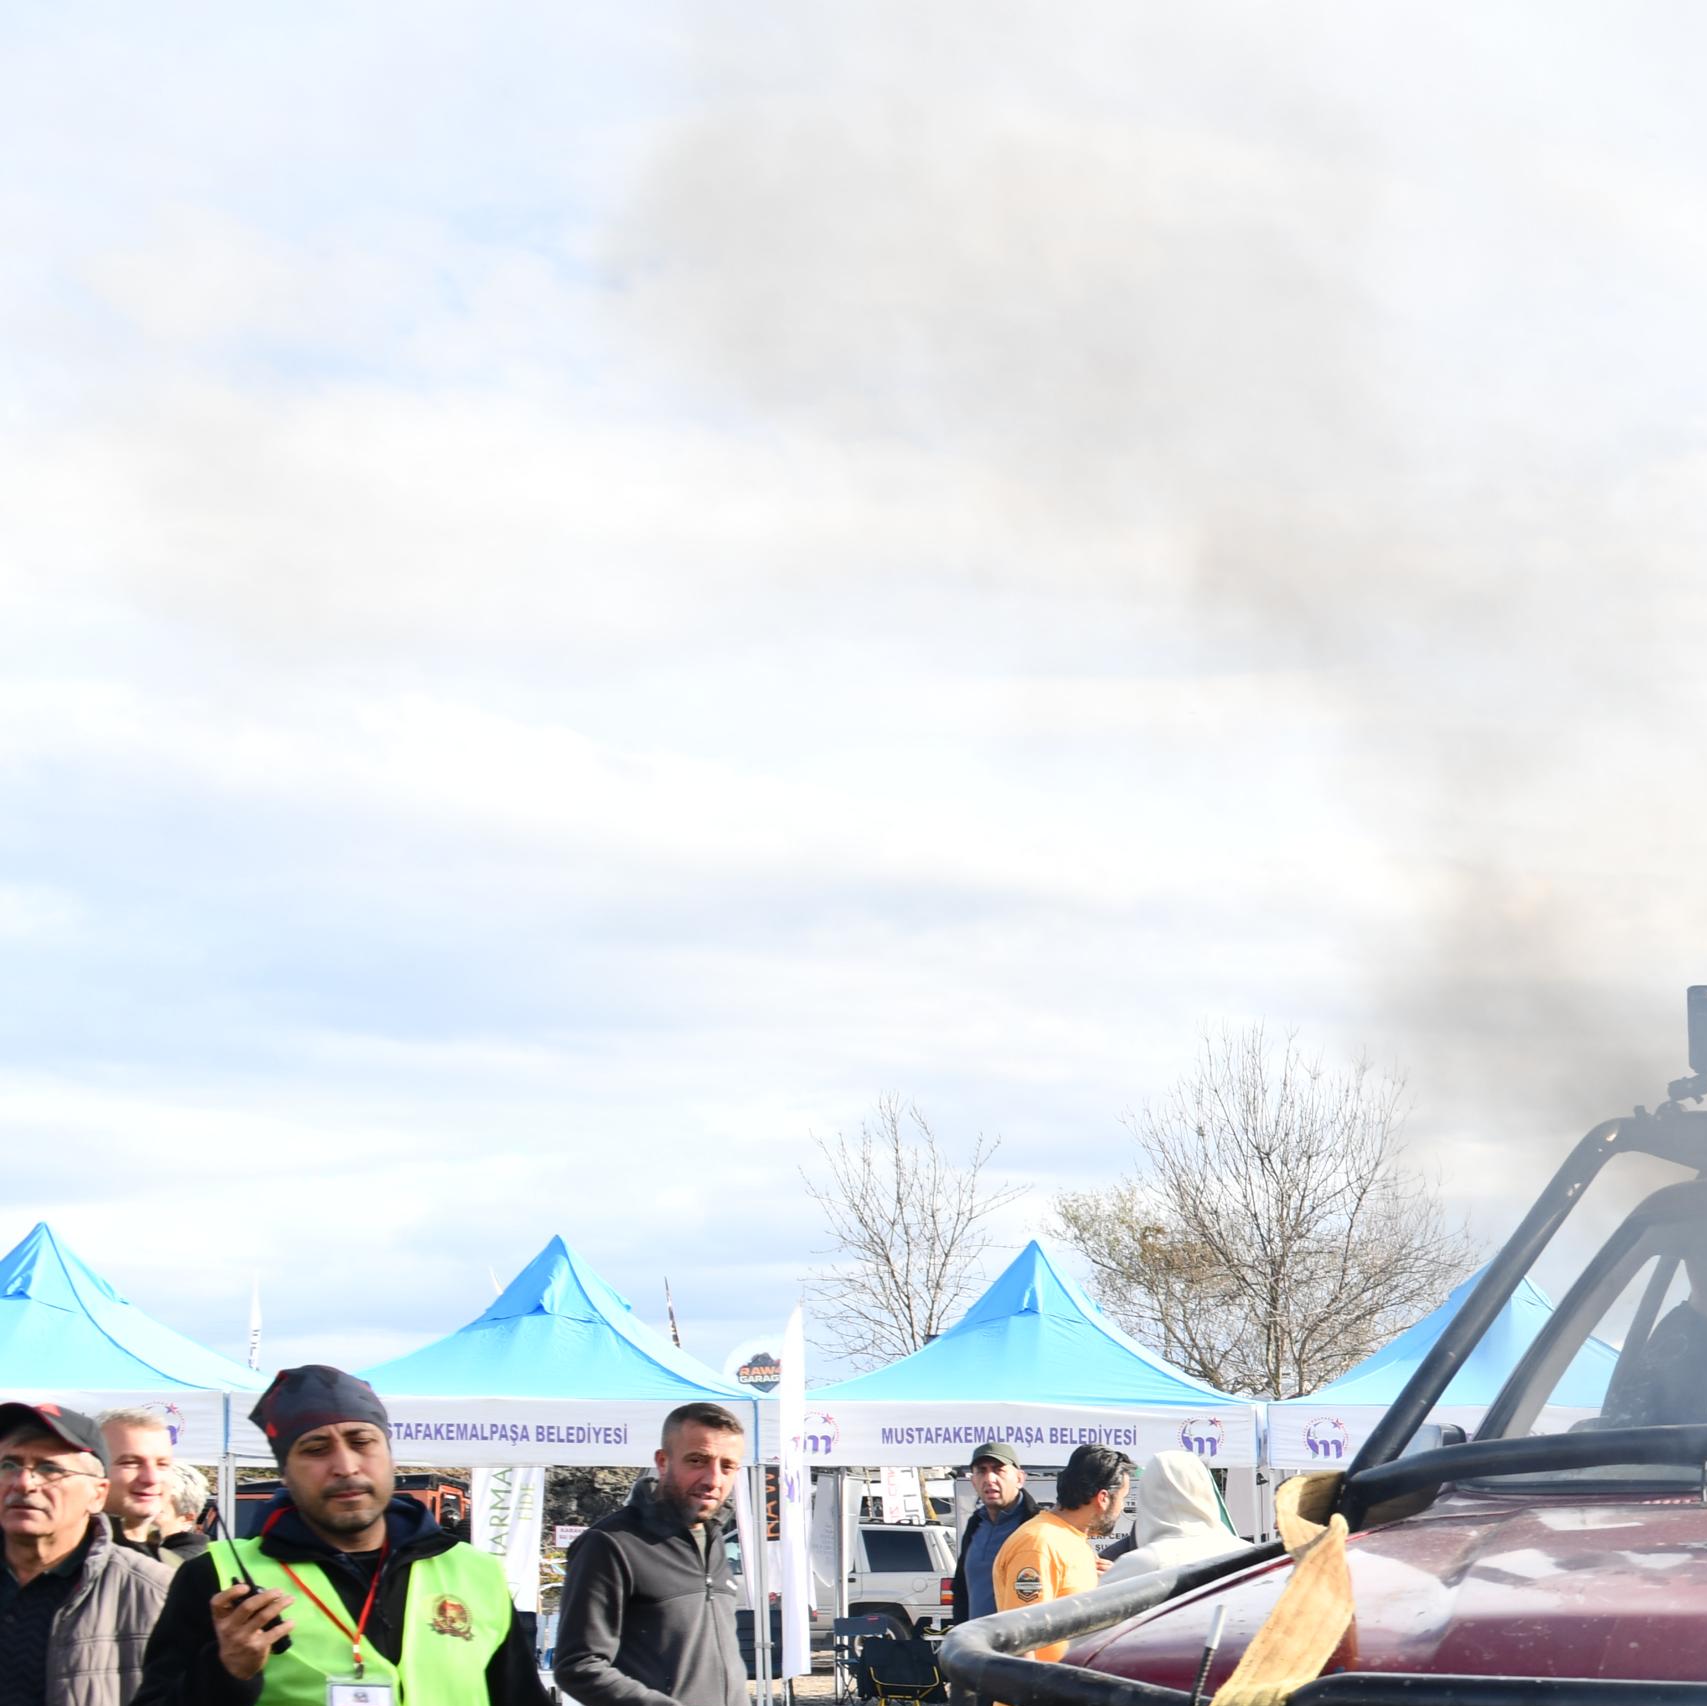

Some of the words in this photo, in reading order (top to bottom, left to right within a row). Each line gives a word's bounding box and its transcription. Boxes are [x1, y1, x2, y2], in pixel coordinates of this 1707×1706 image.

[739, 1375, 781, 1383] GARAG
[385, 1421, 530, 1447] STAFAKEMALPAŞA
[535, 1422, 628, 1445] BELEDİYESİ
[881, 1425, 1045, 1448] MUSTAFAKEMALPAŞA
[1049, 1424, 1138, 1446] BELEDİYESİ
